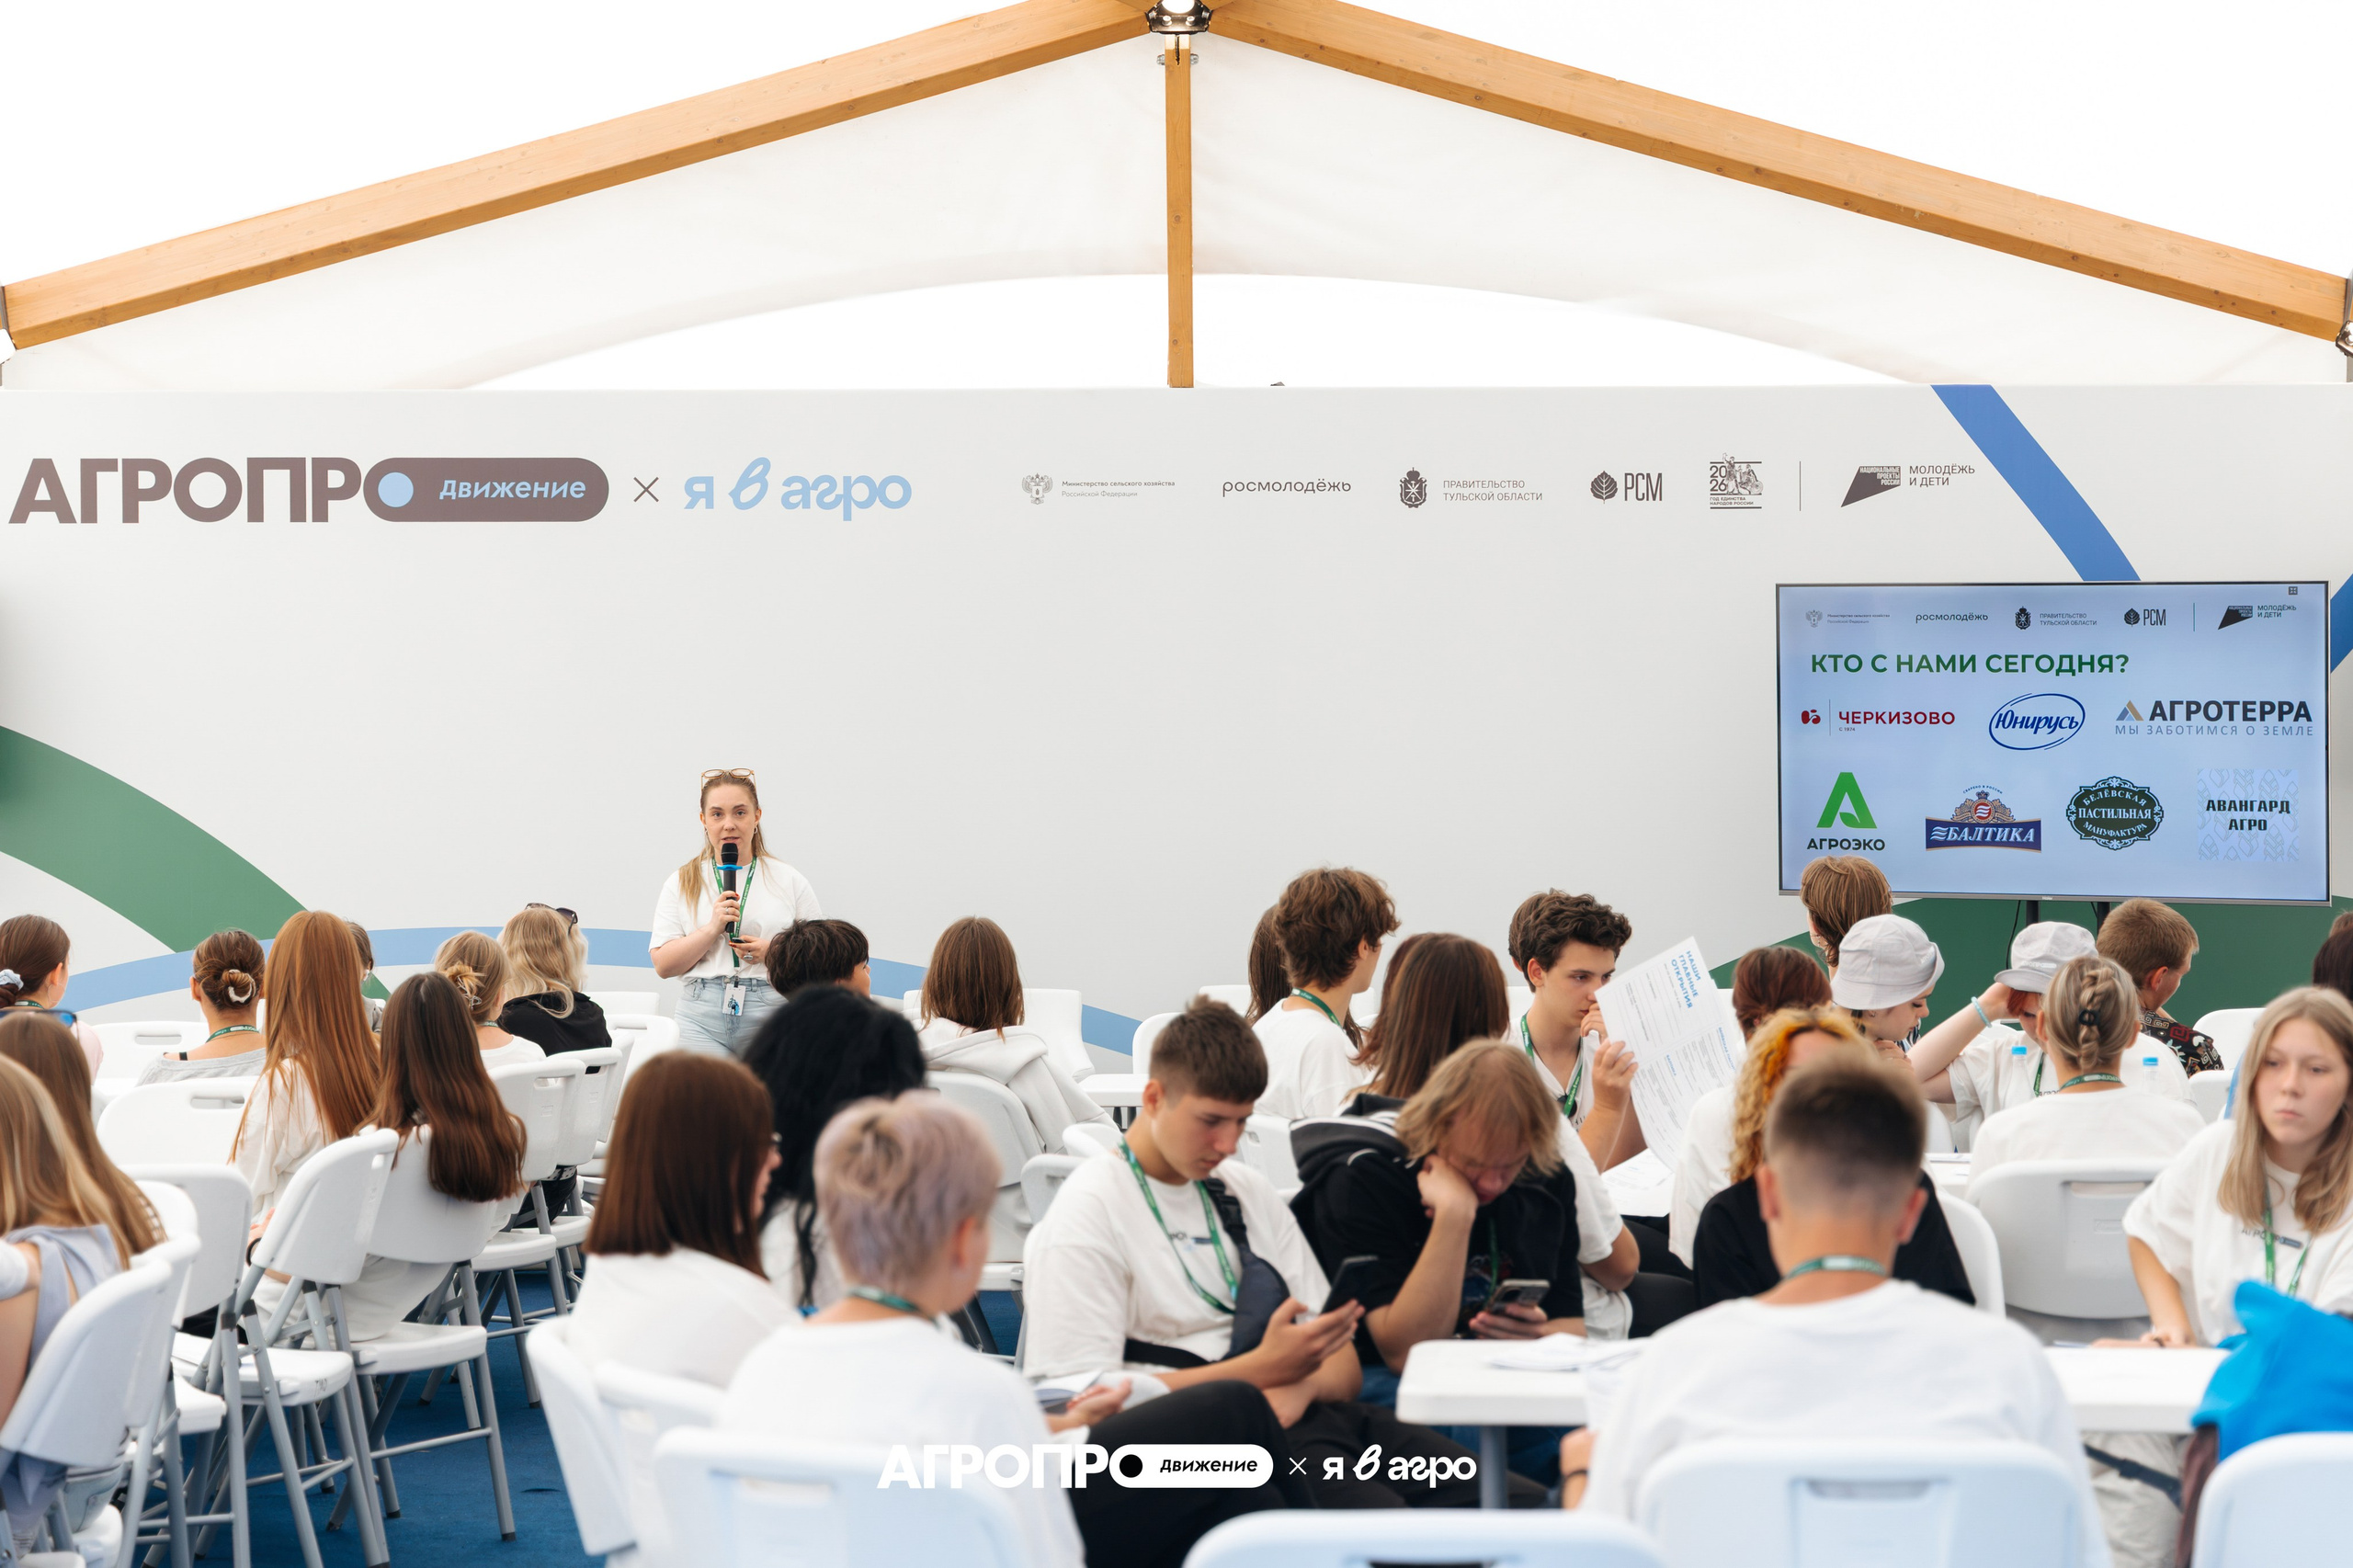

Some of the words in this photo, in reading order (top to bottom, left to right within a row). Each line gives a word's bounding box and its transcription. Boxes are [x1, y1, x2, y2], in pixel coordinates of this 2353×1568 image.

[1710, 465, 1728, 478] 20
[1909, 463, 1975, 475] МОЛОДЁЖЬ
[439, 477, 586, 500] движение
[684, 476, 714, 509] я
[728, 457, 771, 510] в
[781, 474, 912, 521] агро
[1222, 479, 1351, 497] росмолодёжь
[1443, 480, 1525, 489] ПРАВИТЕЛЬСТВО
[1624, 472, 1663, 501] РСМ
[1710, 479, 1728, 492] 26
[1909, 477, 1917, 486] И
[1919, 476, 1949, 487] ДЕТИ
[1100, 490, 1138, 498] Федерации
[1443, 491, 1495, 502] ТУЛЬСКОЙ
[1497, 493, 1543, 501] ОБЛАСТИ
[1915, 613, 1988, 623] росмолодёжь
[2143, 608, 2166, 626] РСМ
[1812, 654, 1863, 673] КТО
[1870, 654, 1888, 673] С
[1896, 654, 1976, 673] НАМИ
[1985, 654, 2130, 676] СЕГОДНЯ?
[1838, 711, 1955, 725] ЧЕРКИЗОВО
[2149, 700, 2313, 722] АГРОТЕРРА
[1995, 710, 2079, 734] Юнирусь
[2115, 725, 2140, 735] МЫ
[2146, 725, 2238, 735] ЗАБОТИМСЯ
[2245, 726, 2256, 735] О
[2263, 726, 2313, 736] ЗЕМЛЕ
[2083, 789, 2147, 807] БЕЛЁВСКАЯ
[2078, 808, 2152, 820] ПАСТИЛЬНАЯ
[2206, 800, 2290, 814] АВАНГАРД
[2083, 821, 2147, 837] МАНУФАКТУРА
[2229, 819, 2268, 831] АГРО
[1946, 826, 2035, 843] БАЛТИКА
[1807, 838, 1885, 851] АГРОЭКО
[1686, 950, 1701, 981] НАШИ
[1678, 954, 1699, 998] ГЛАВНЫЕ
[1671, 959, 1693, 1009] ОТКРЫТИЯ
